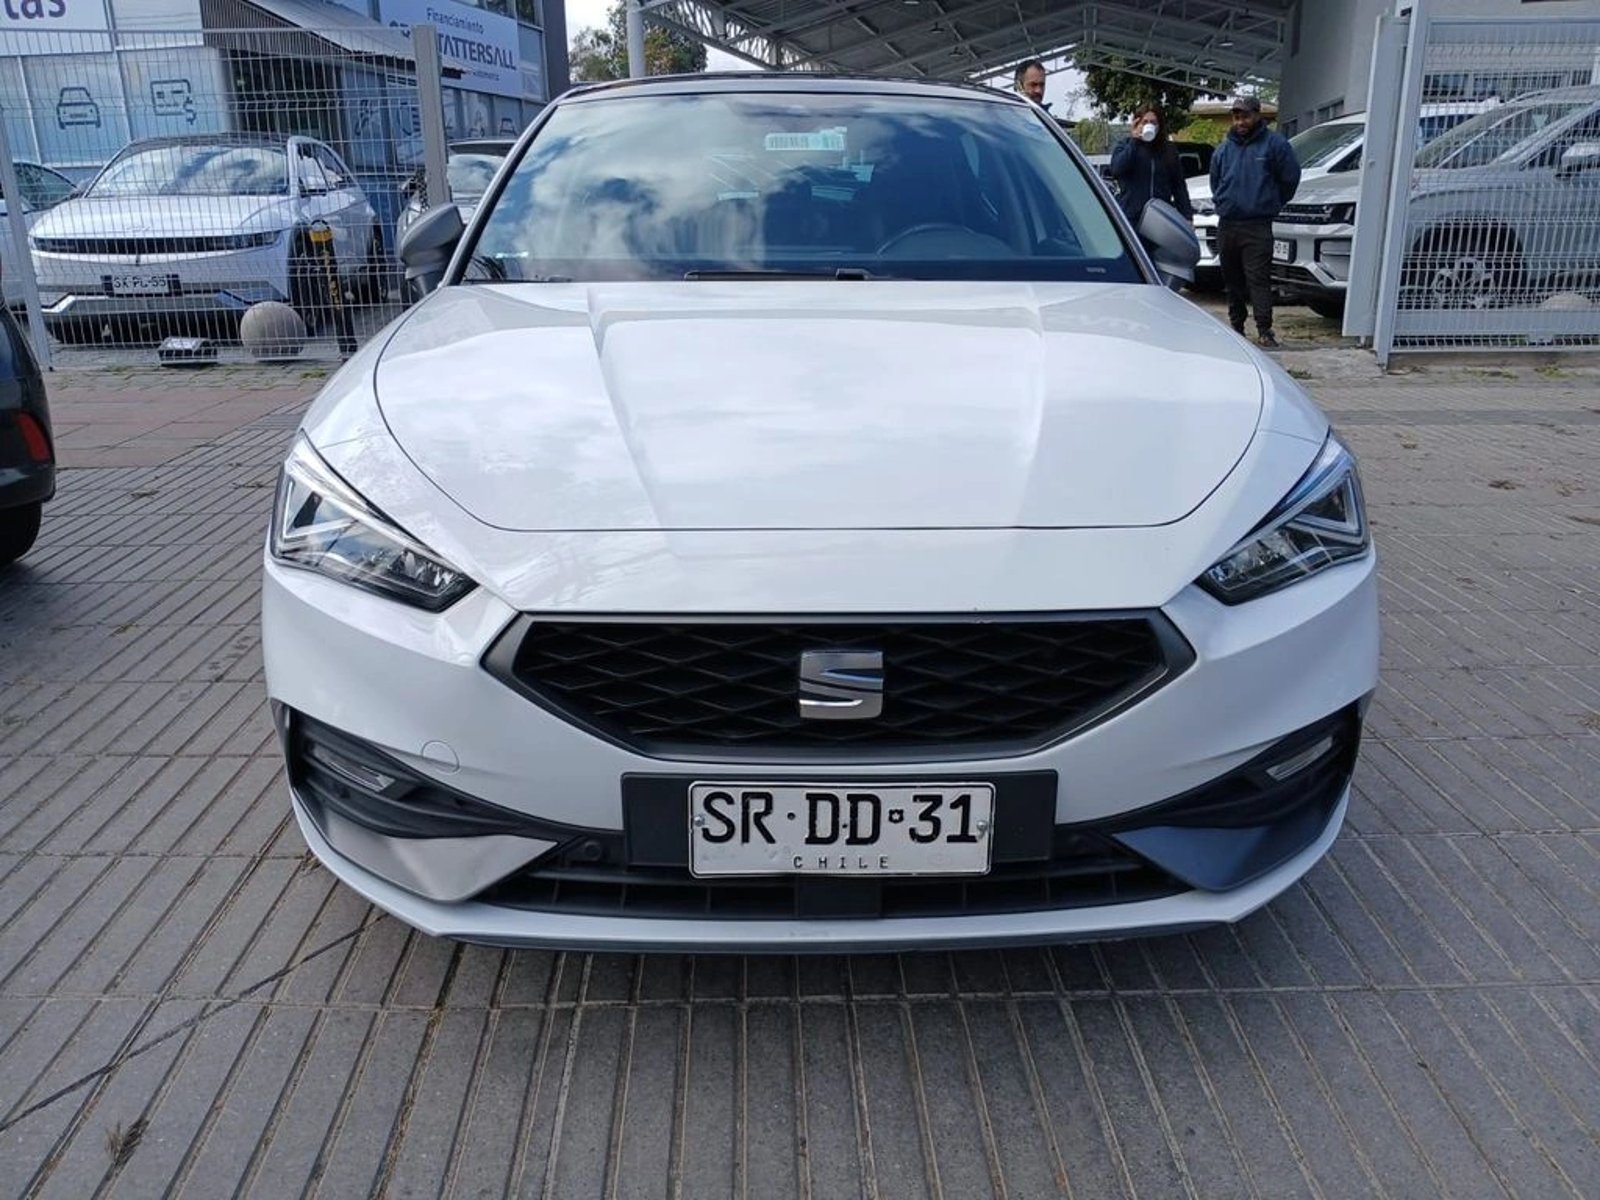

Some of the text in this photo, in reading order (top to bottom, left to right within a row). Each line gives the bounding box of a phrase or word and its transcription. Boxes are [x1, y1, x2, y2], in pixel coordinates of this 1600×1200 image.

[426, 7, 484, 35] Financiamiento
[437, 33, 517, 70] TATTERSALL
[793, 856, 889, 869] CHILE
